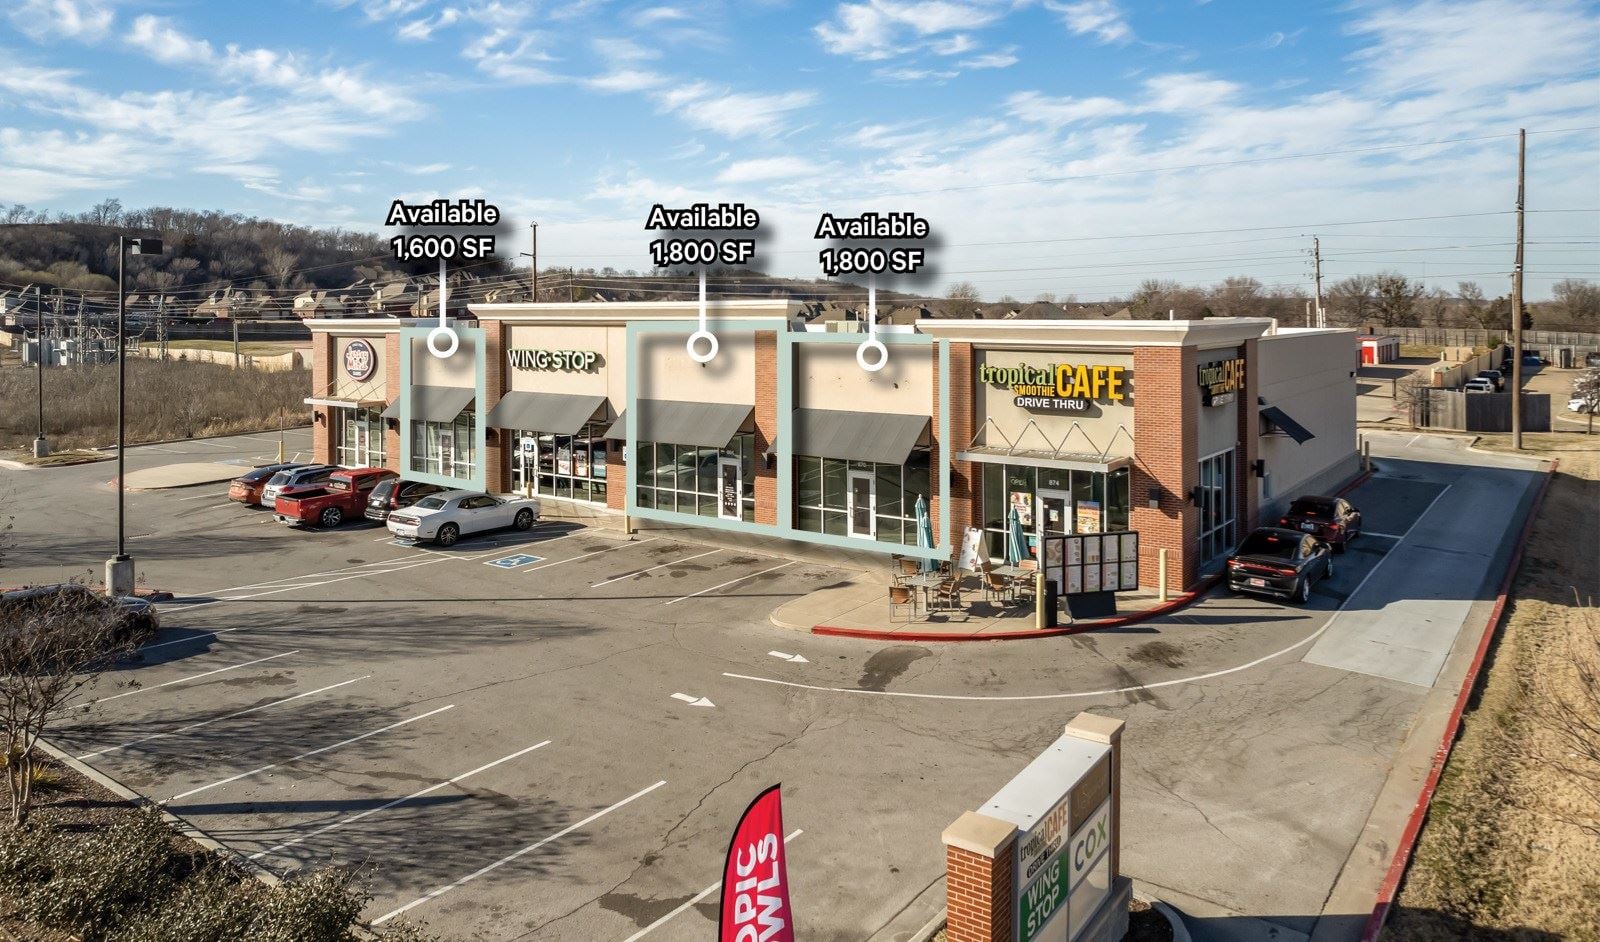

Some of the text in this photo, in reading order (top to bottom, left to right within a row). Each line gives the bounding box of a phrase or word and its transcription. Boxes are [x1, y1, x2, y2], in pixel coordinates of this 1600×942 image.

[979, 362, 1125, 400] tropical CAFE
[1013, 384, 1056, 397] SMOOTHIE
[1016, 397, 1084, 410] DRIVE THRU
[1075, 814, 1107, 872] COX
[1027, 859, 1060, 911] WING
[1027, 883, 1060, 938] STOP
